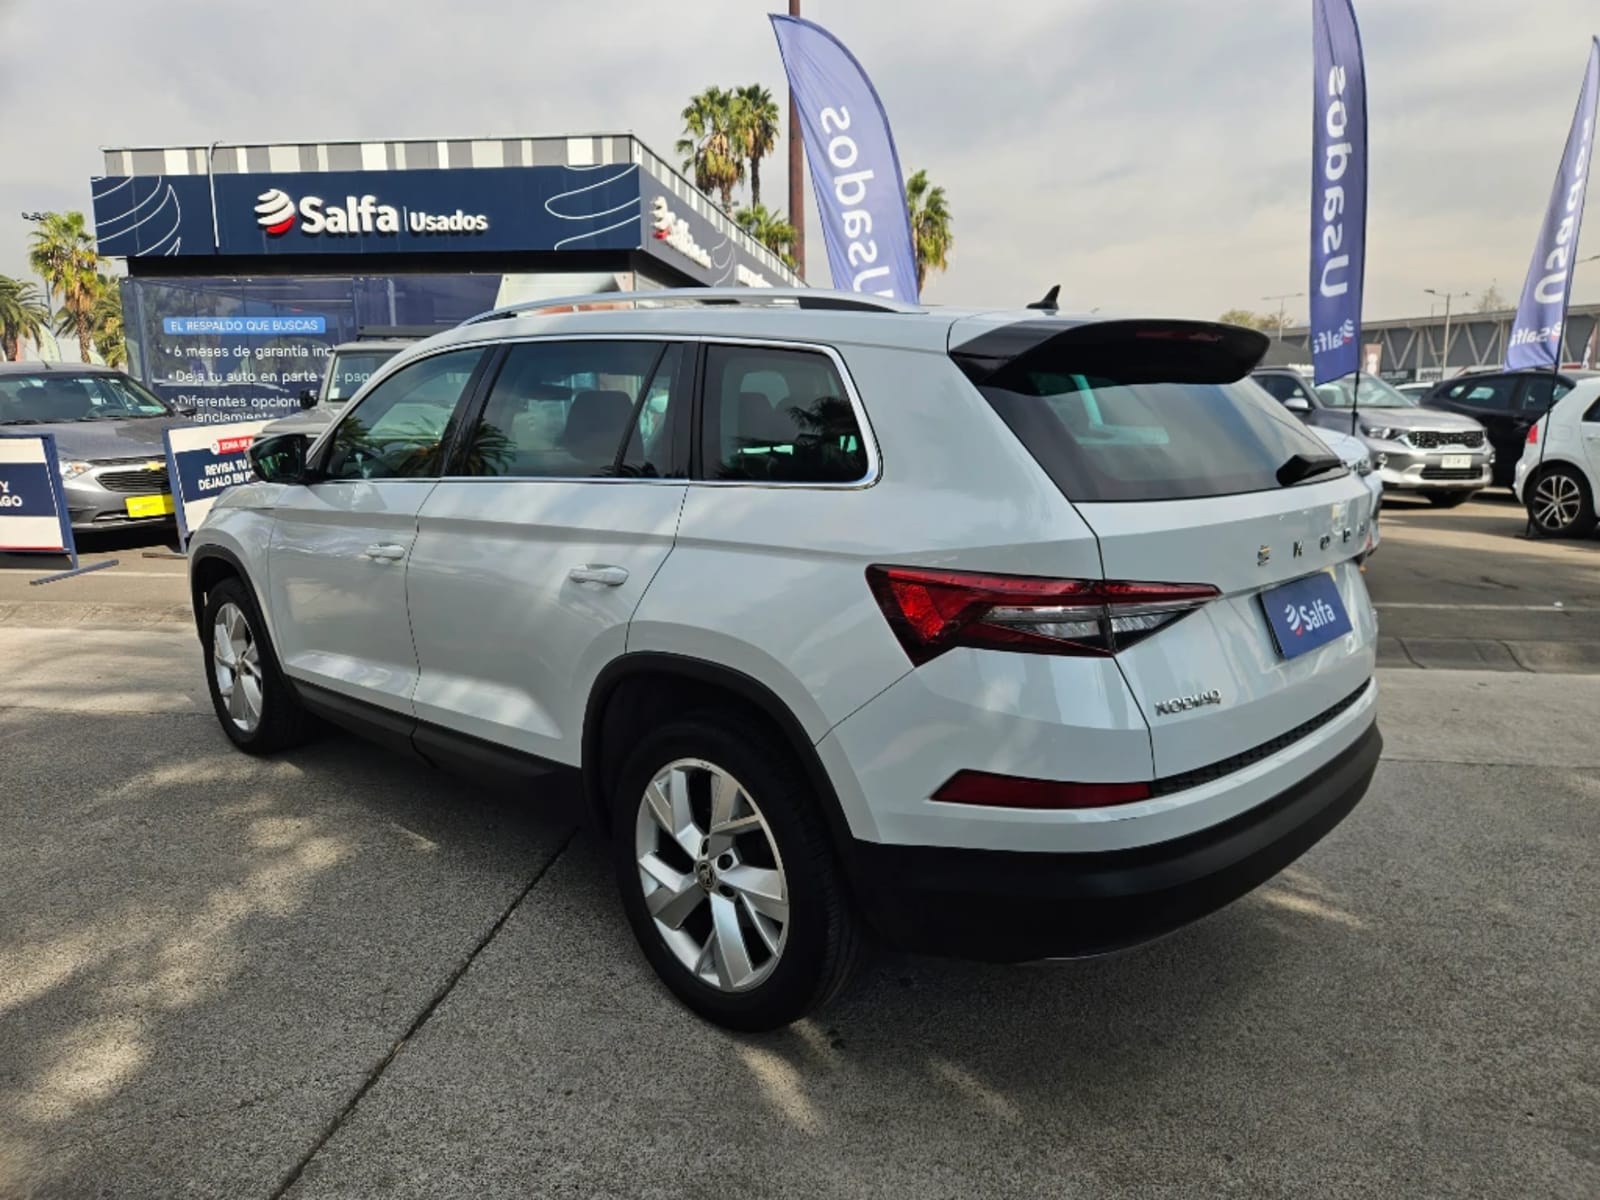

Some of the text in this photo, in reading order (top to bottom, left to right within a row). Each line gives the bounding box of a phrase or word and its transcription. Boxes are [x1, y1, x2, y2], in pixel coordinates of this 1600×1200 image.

[299, 195, 489, 234] Salfa Usados
[171, 319, 318, 331] EL RESPALDO QUE BUSCAS
[174, 345, 182, 357] 6
[186, 347, 229, 357] meses
[233, 345, 250, 357] de
[176, 370, 204, 384] Deja
[209, 371, 222, 382] tu
[226, 371, 257, 382] auto
[261, 372, 278, 382] en
[282, 370, 318, 384] parte
[344, 373, 370, 384] pag
[178, 395, 247, 407] Diferentes
[204, 461, 235, 476] REVISA
[236, 459, 247, 470] TU
[198, 474, 231, 490] DEJALO
[232, 472, 244, 483] EN
[0, 495, 23, 507] GO
[1300, 598, 1336, 631] Salfa
